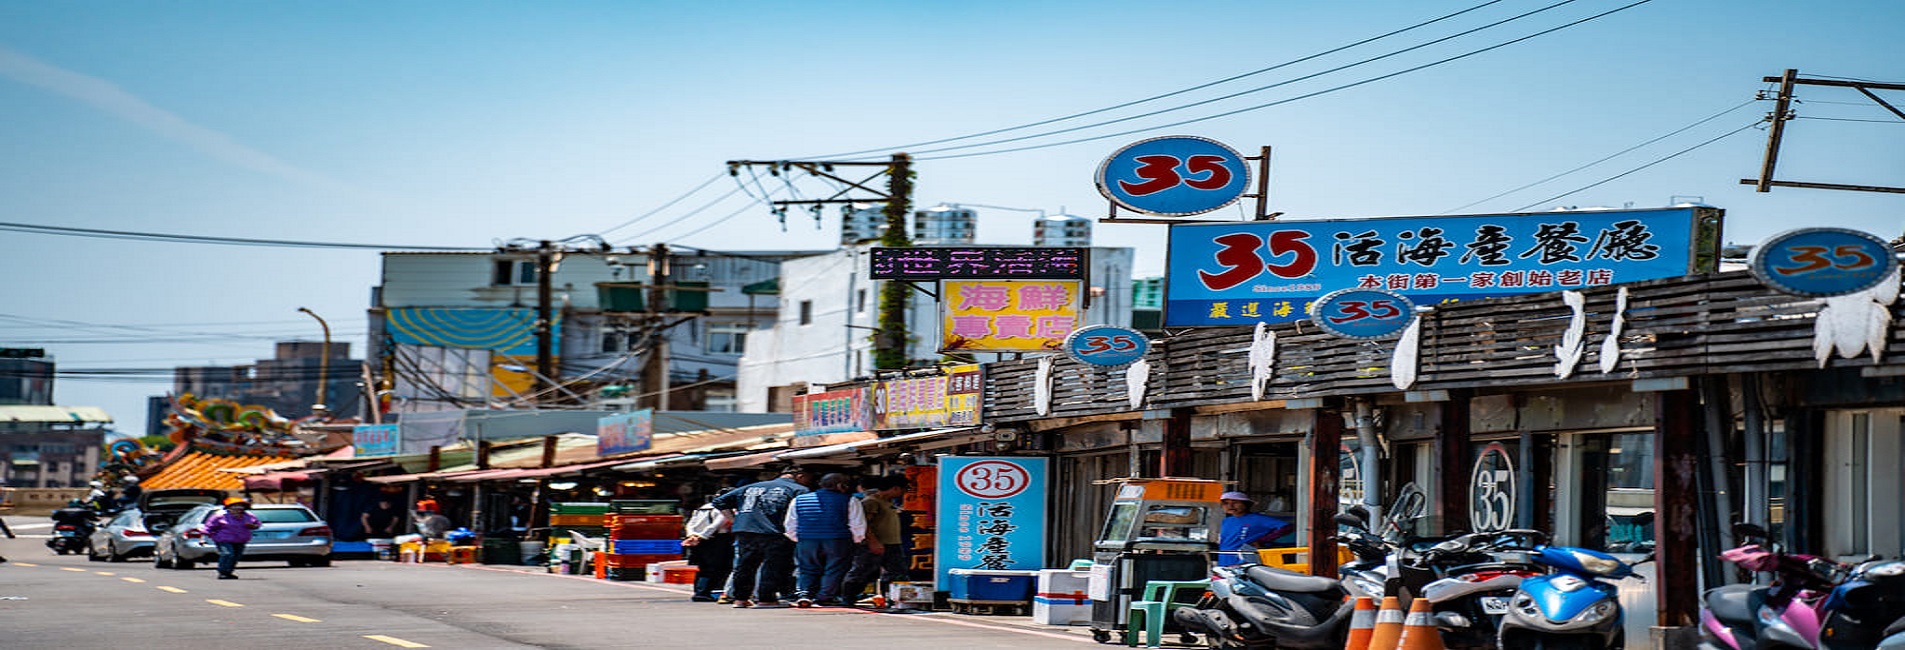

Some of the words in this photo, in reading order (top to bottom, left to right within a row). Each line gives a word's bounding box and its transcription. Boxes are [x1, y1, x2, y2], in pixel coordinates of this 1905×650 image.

[1118, 154, 1233, 197] 35
[1331, 220, 1662, 267] 活海產餐廳
[1197, 230, 1318, 291] 35
[1773, 245, 1875, 276] 35
[1357, 269, 1614, 291] 本街第一家創始老店
[958, 284, 1069, 311] 海鮮
[1329, 299, 1401, 324] 35
[951, 314, 1074, 340] 專賣店
[1078, 335, 1137, 355] 35
[970, 467, 1015, 491] 35
[1474, 470, 1510, 530] 35
